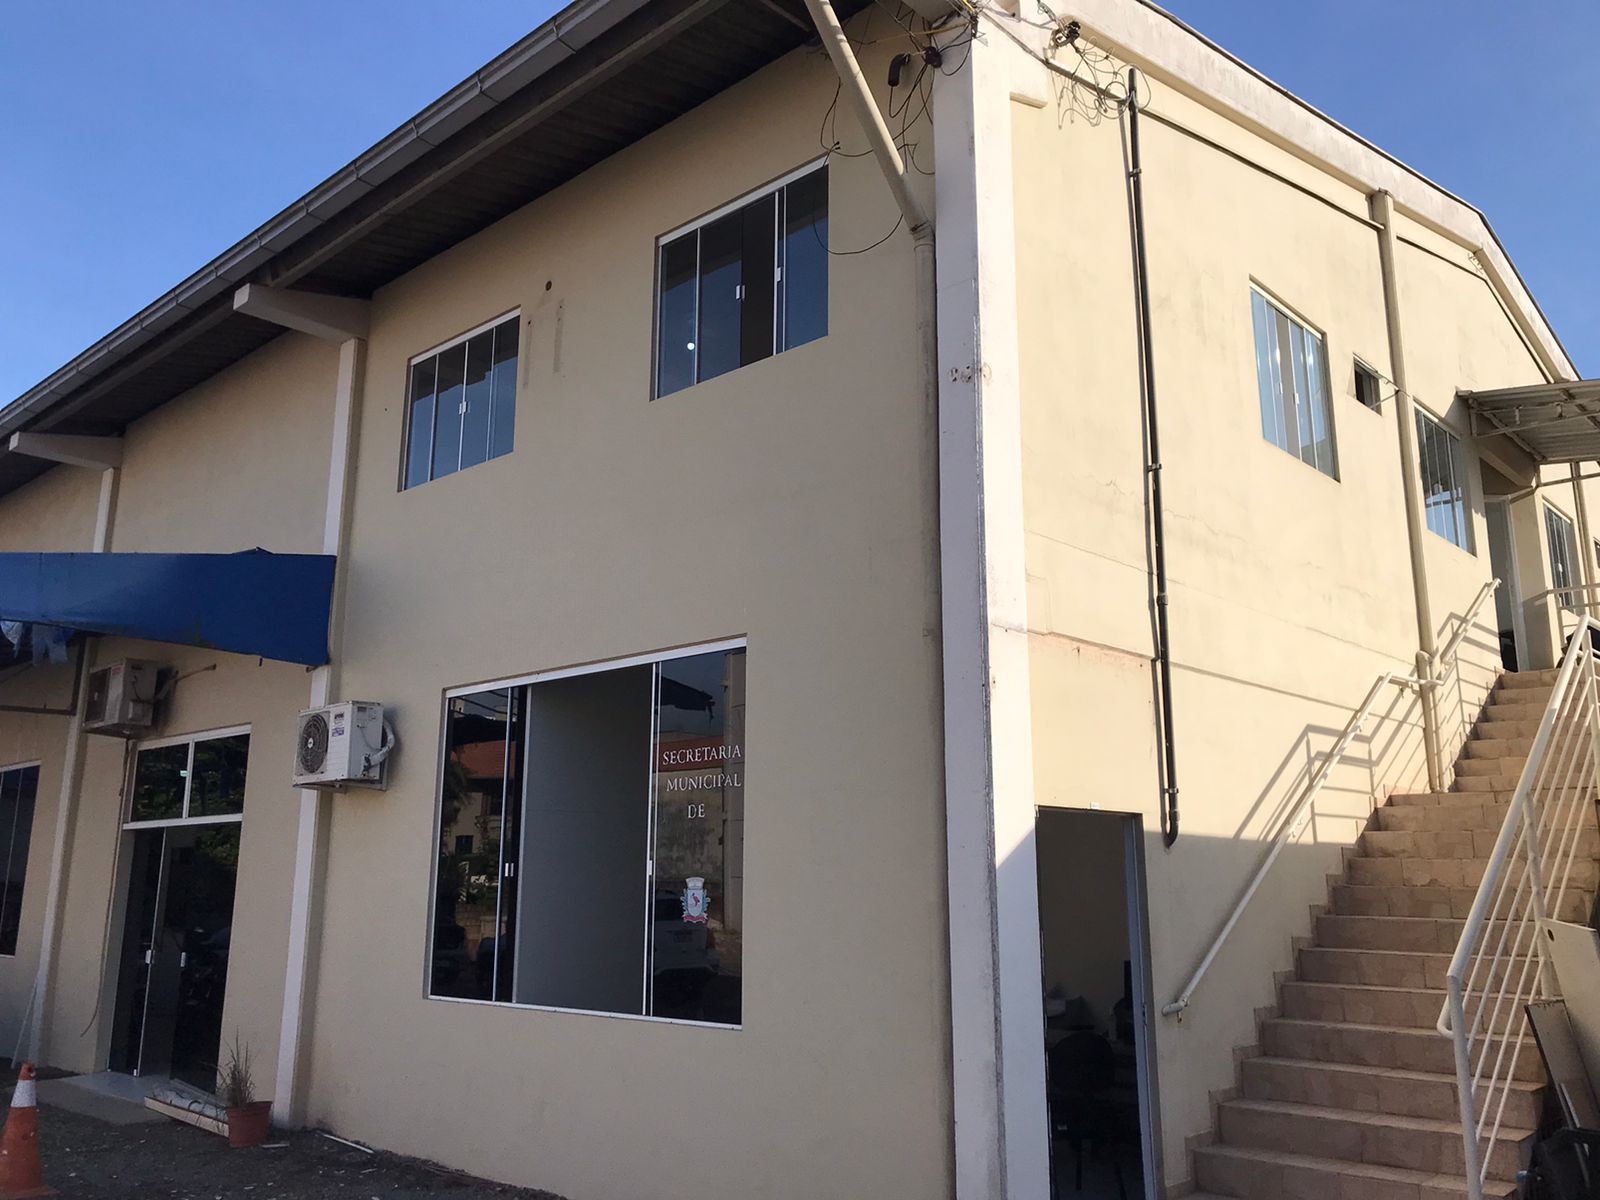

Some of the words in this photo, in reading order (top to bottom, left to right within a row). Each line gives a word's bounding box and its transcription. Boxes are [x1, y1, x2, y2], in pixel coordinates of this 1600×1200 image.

[663, 745, 741, 765] SECRETARIA
[666, 773, 741, 792] MUNICIPAL
[688, 804, 705, 819] DE
